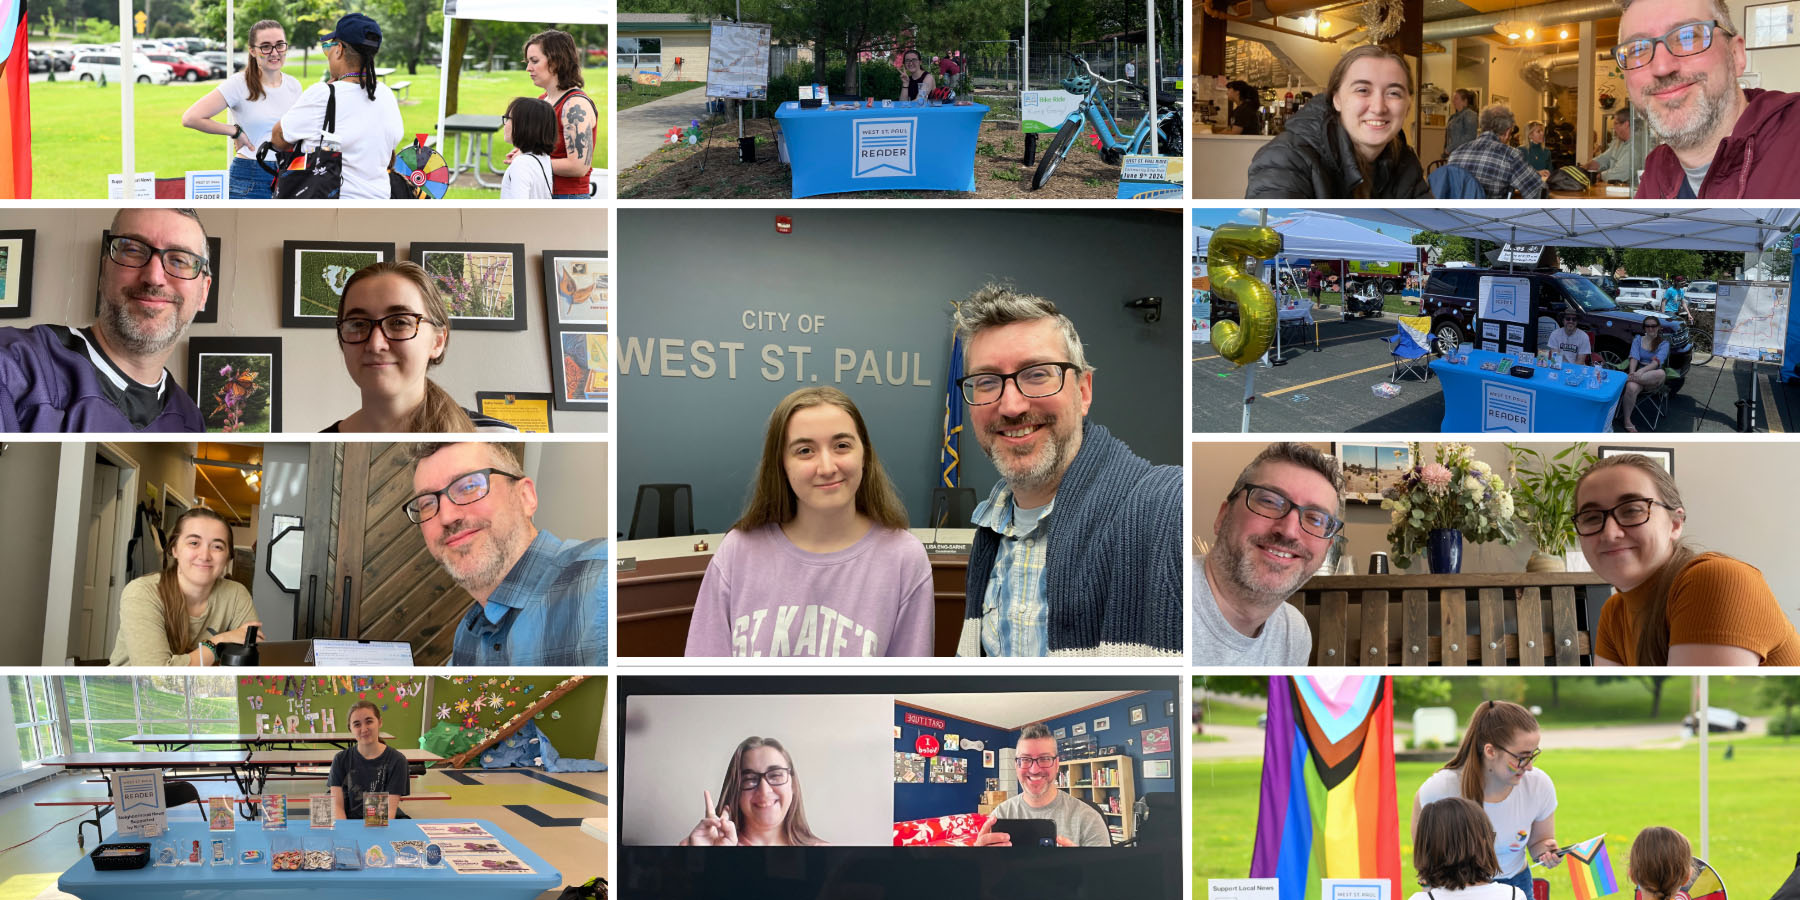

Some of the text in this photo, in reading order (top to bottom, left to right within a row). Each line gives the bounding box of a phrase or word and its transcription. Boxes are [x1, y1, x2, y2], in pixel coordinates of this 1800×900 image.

[862, 148, 907, 158] READER
[742, 310, 825, 334] CITY OF
[617, 336, 932, 386] WEST ST. PAUL
[1488, 410, 1527, 424] READER
[732, 609, 768, 657] ST.
[247, 696, 264, 710] TO
[286, 698, 312, 715] THE
[256, 708, 336, 735] EARTH
